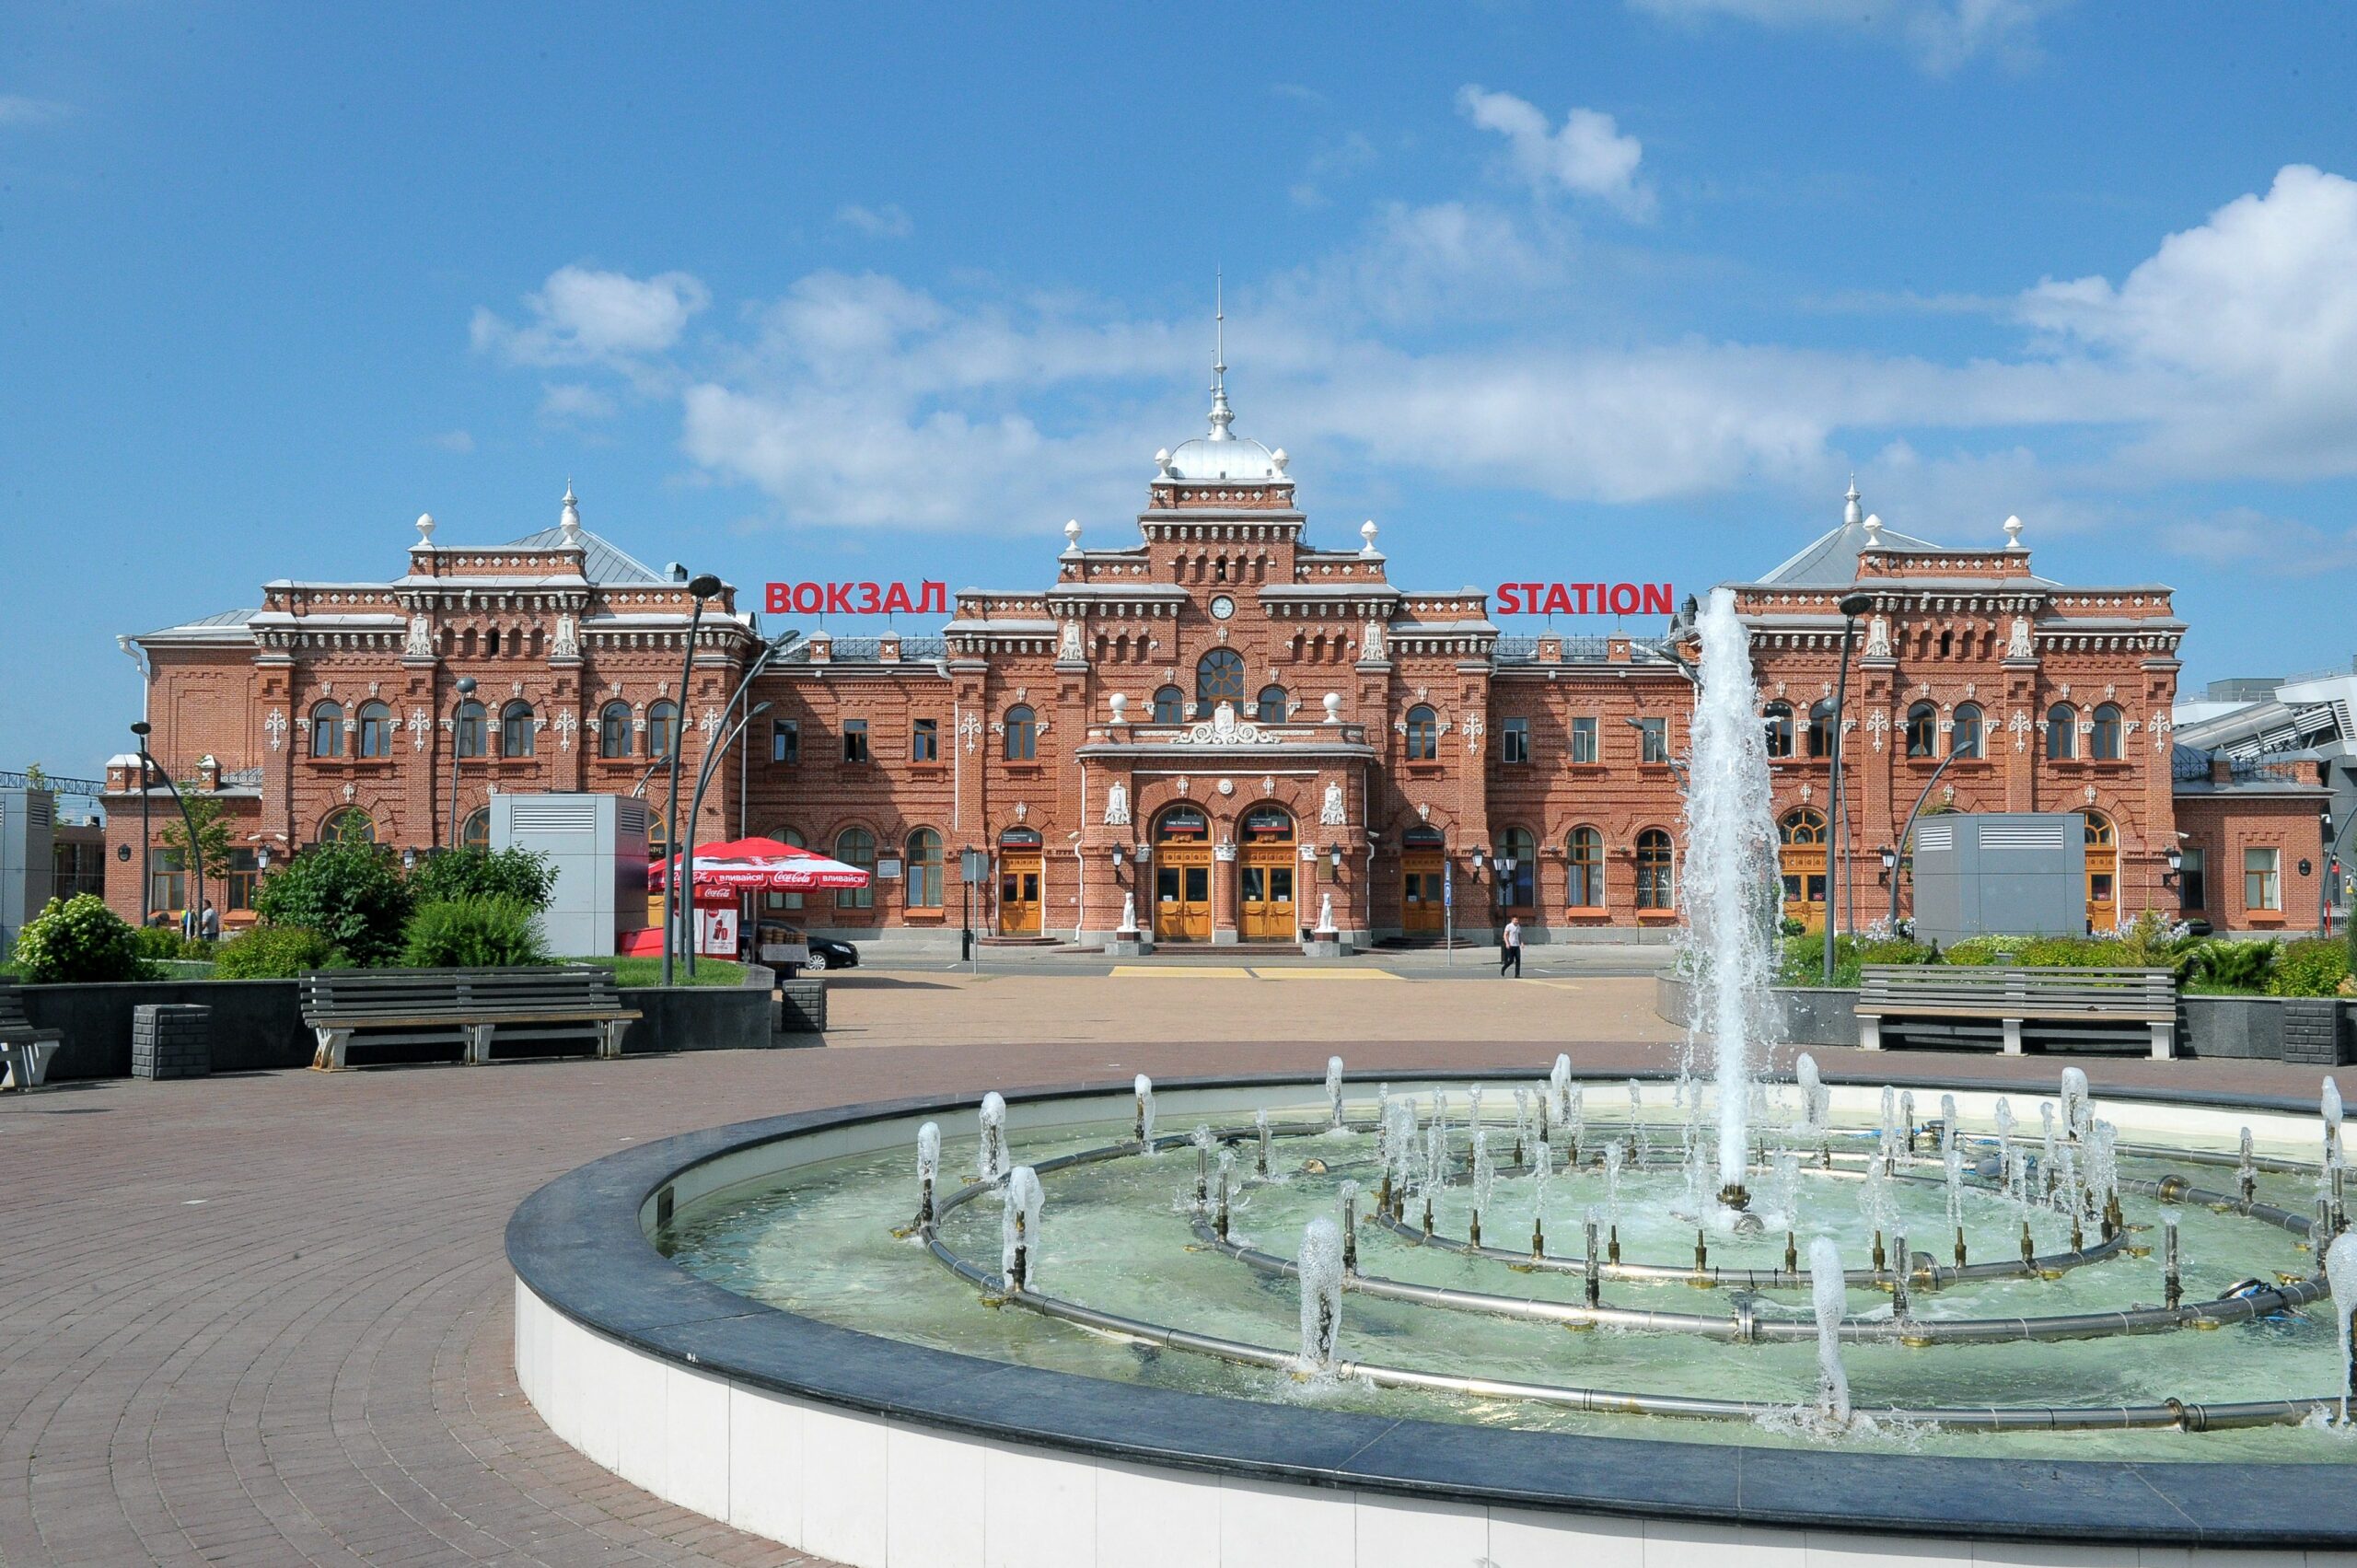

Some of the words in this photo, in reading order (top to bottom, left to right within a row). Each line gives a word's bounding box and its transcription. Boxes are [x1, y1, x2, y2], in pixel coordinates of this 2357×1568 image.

[765, 582, 946, 614] ВОКЗАЛ
[1497, 582, 1673, 614] STATION
[822, 874, 866, 883] вливайся!
